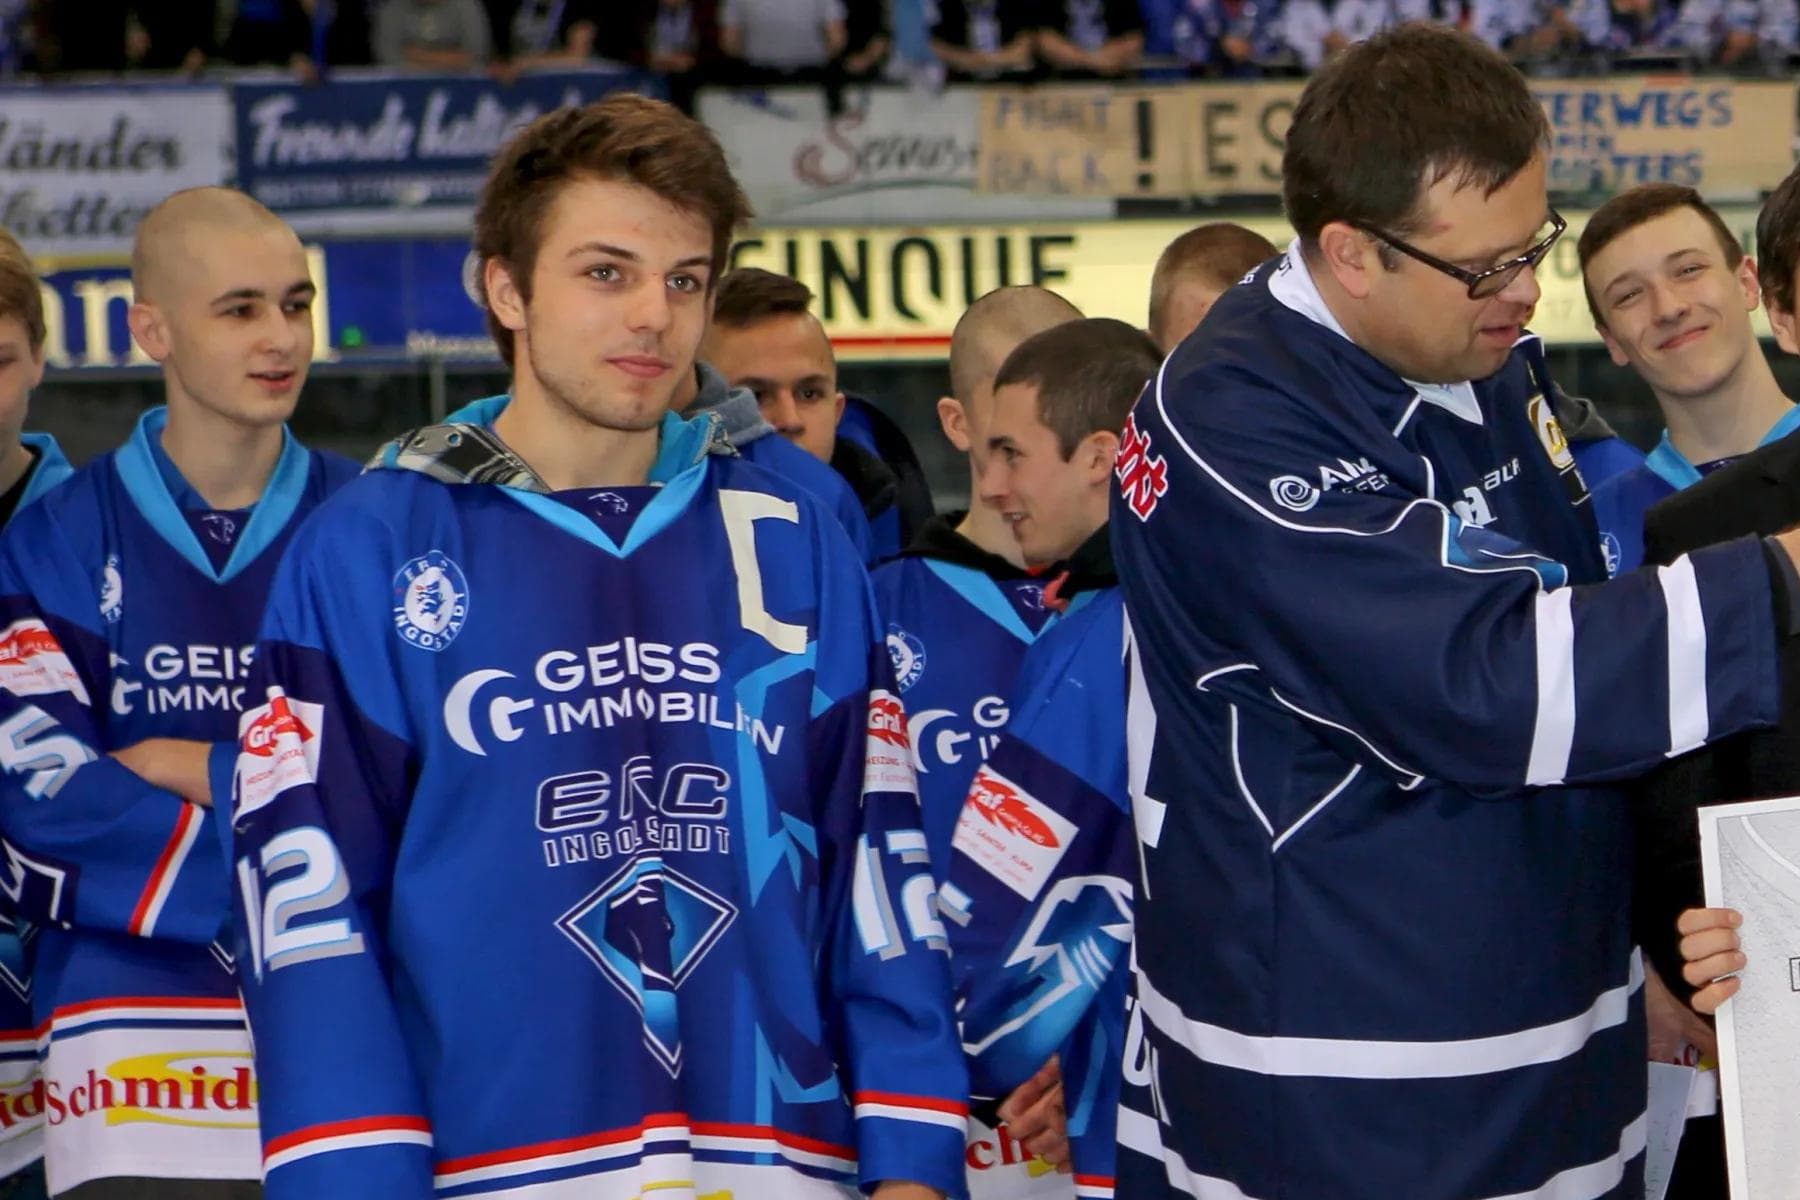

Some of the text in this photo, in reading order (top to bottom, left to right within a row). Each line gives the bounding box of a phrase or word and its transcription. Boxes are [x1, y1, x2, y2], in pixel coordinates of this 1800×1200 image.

[535, 636, 722, 693] GEISS
[543, 686, 785, 756] IMMOBILIN
[535, 755, 732, 834] ERC
